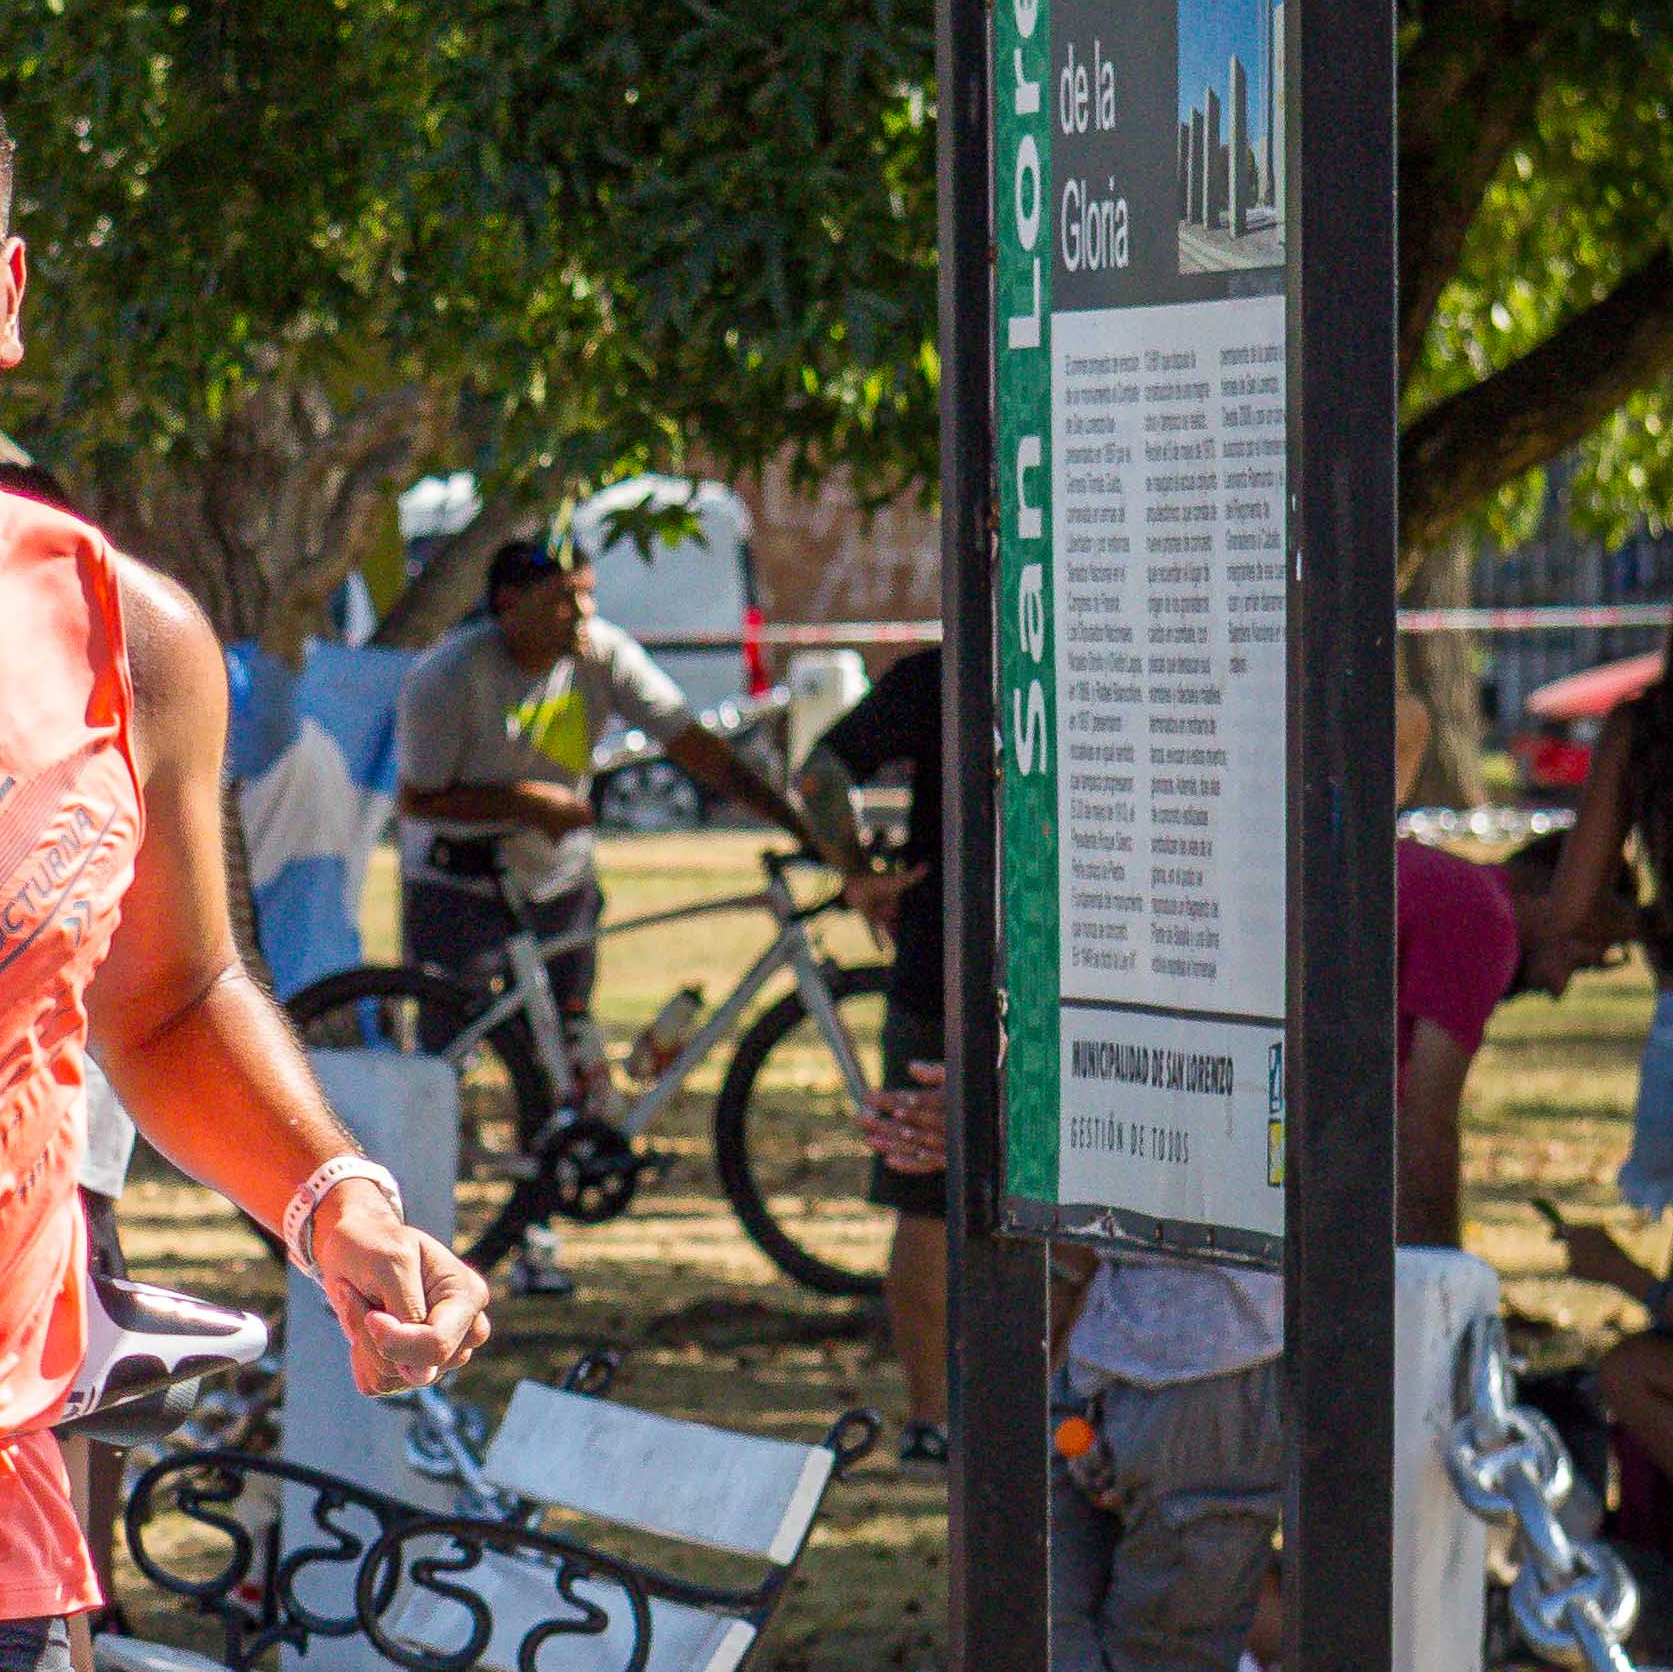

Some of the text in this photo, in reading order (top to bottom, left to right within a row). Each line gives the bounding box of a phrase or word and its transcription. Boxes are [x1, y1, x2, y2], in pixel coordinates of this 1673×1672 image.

[1060, 38, 1116, 135] de la
[1060, 175, 1130, 272] Gloria
[1012, 434, 1046, 776] San
[1071, 1040, 1234, 1096] MUNICIPALIDAD DE SAN LORENZO
[1070, 1112, 1124, 1152] GESTIÓN
[1130, 1122, 1145, 1157] DE
